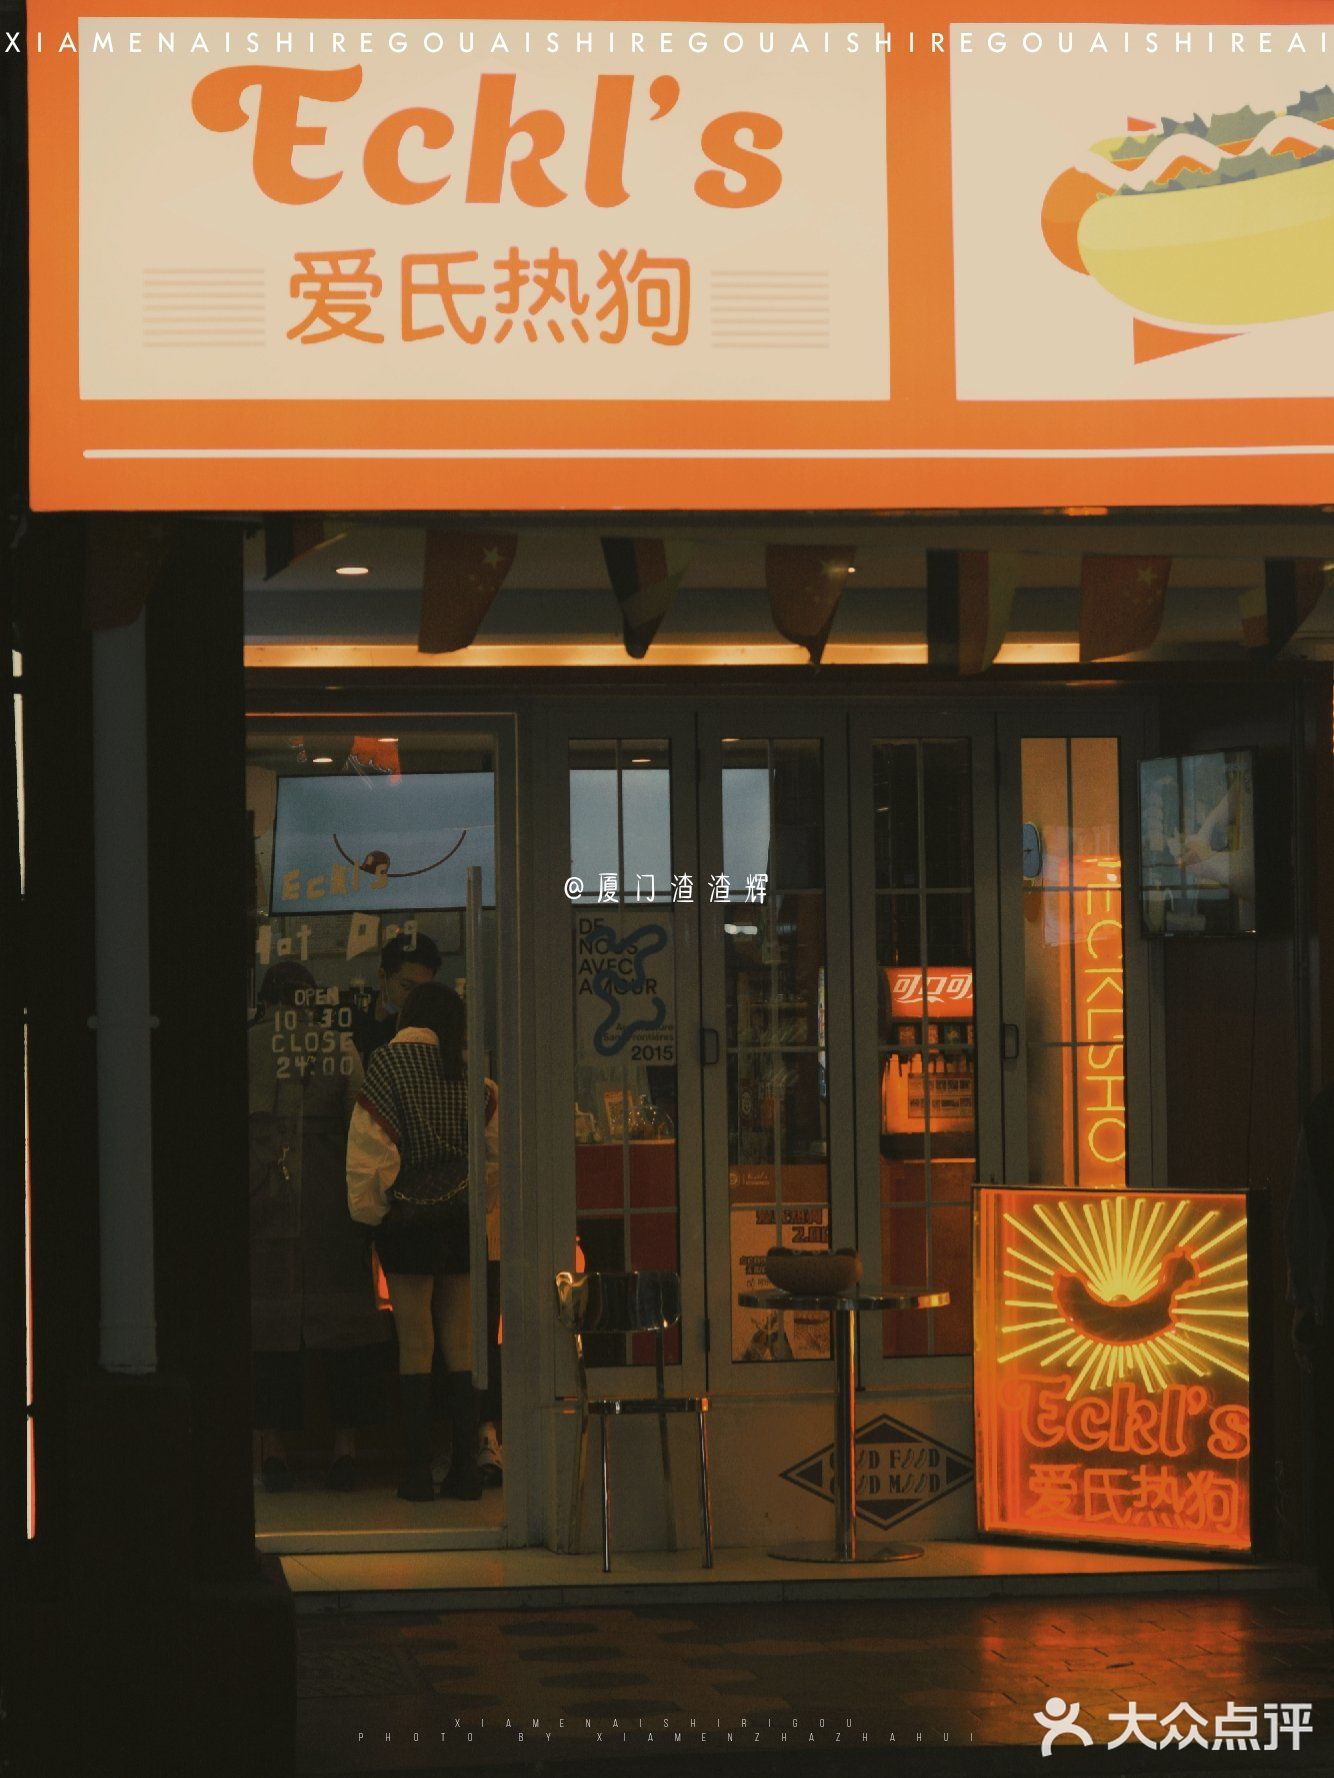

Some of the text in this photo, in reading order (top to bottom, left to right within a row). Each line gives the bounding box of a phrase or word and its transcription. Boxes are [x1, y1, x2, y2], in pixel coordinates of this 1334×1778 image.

[191, 64, 783, 209] Eckl's
[286, 246, 692, 346] 爱氏热狗
[294, 986, 340, 1006] OPEN
[892, 972, 973, 1001] 可口可
[273, 1007, 353, 1033] 10:30
[271, 1030, 355, 1054] CLOSE
[631, 1045, 674, 1061] 2015
[275, 1055, 354, 1079] 24:00
[1002, 1373, 1251, 1460] Eckl's
[1026, 1463, 1240, 1533] 爱氏热狗
